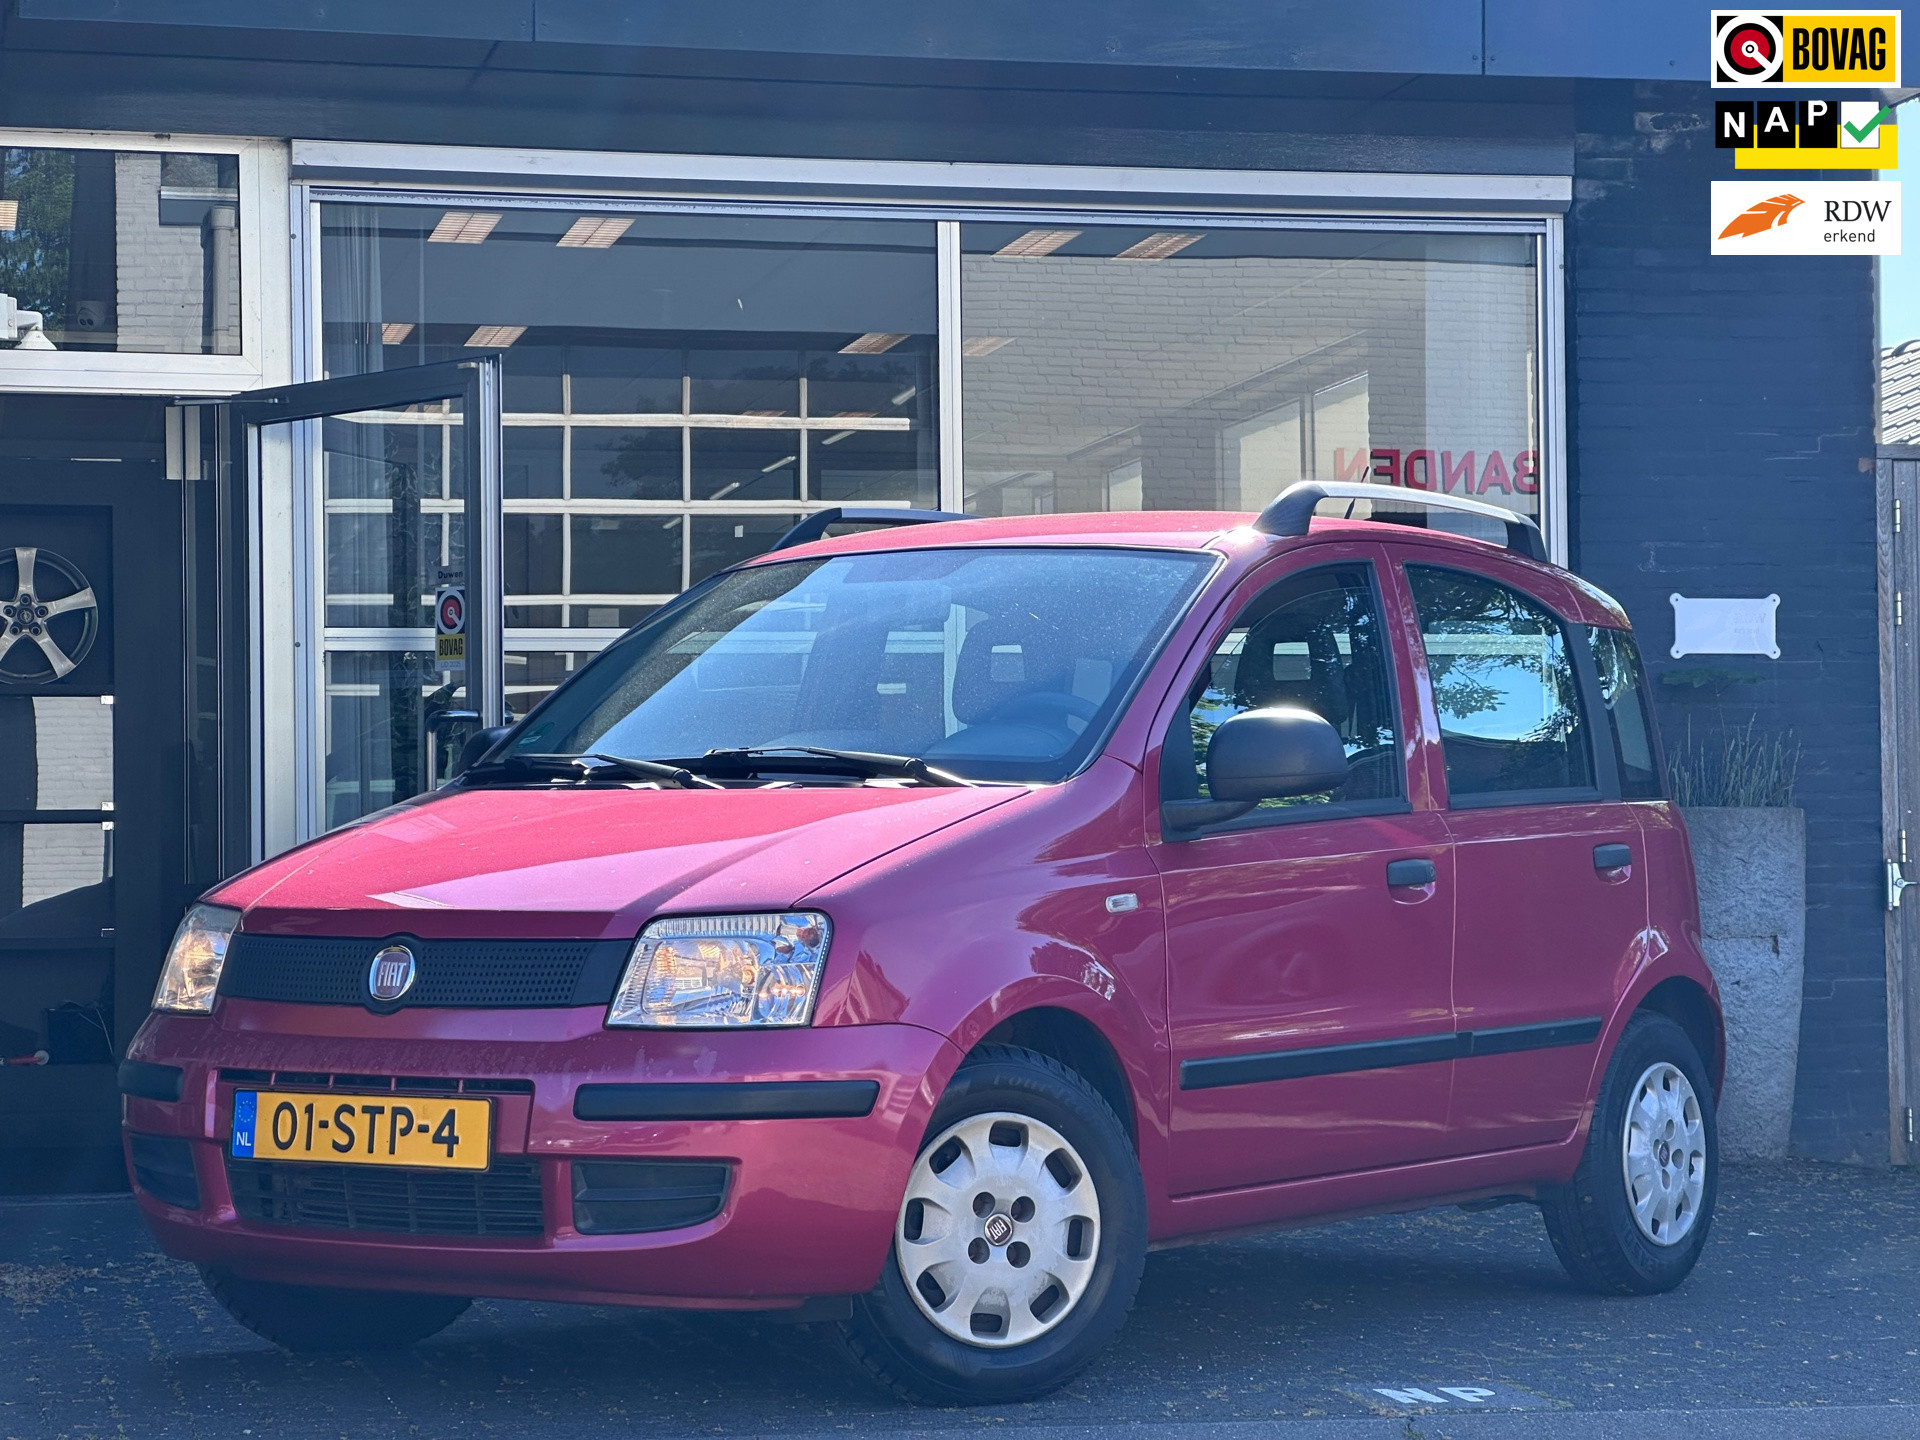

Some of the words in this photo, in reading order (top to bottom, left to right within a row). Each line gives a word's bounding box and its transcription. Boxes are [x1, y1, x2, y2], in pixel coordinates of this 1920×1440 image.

[439, 638, 463, 656] BOVAG
[377, 961, 407, 987] FIAT
[236, 1132, 251, 1146] NL
[272, 1101, 459, 1158] 01-STP-4
[989, 1219, 1008, 1240] FIAT
